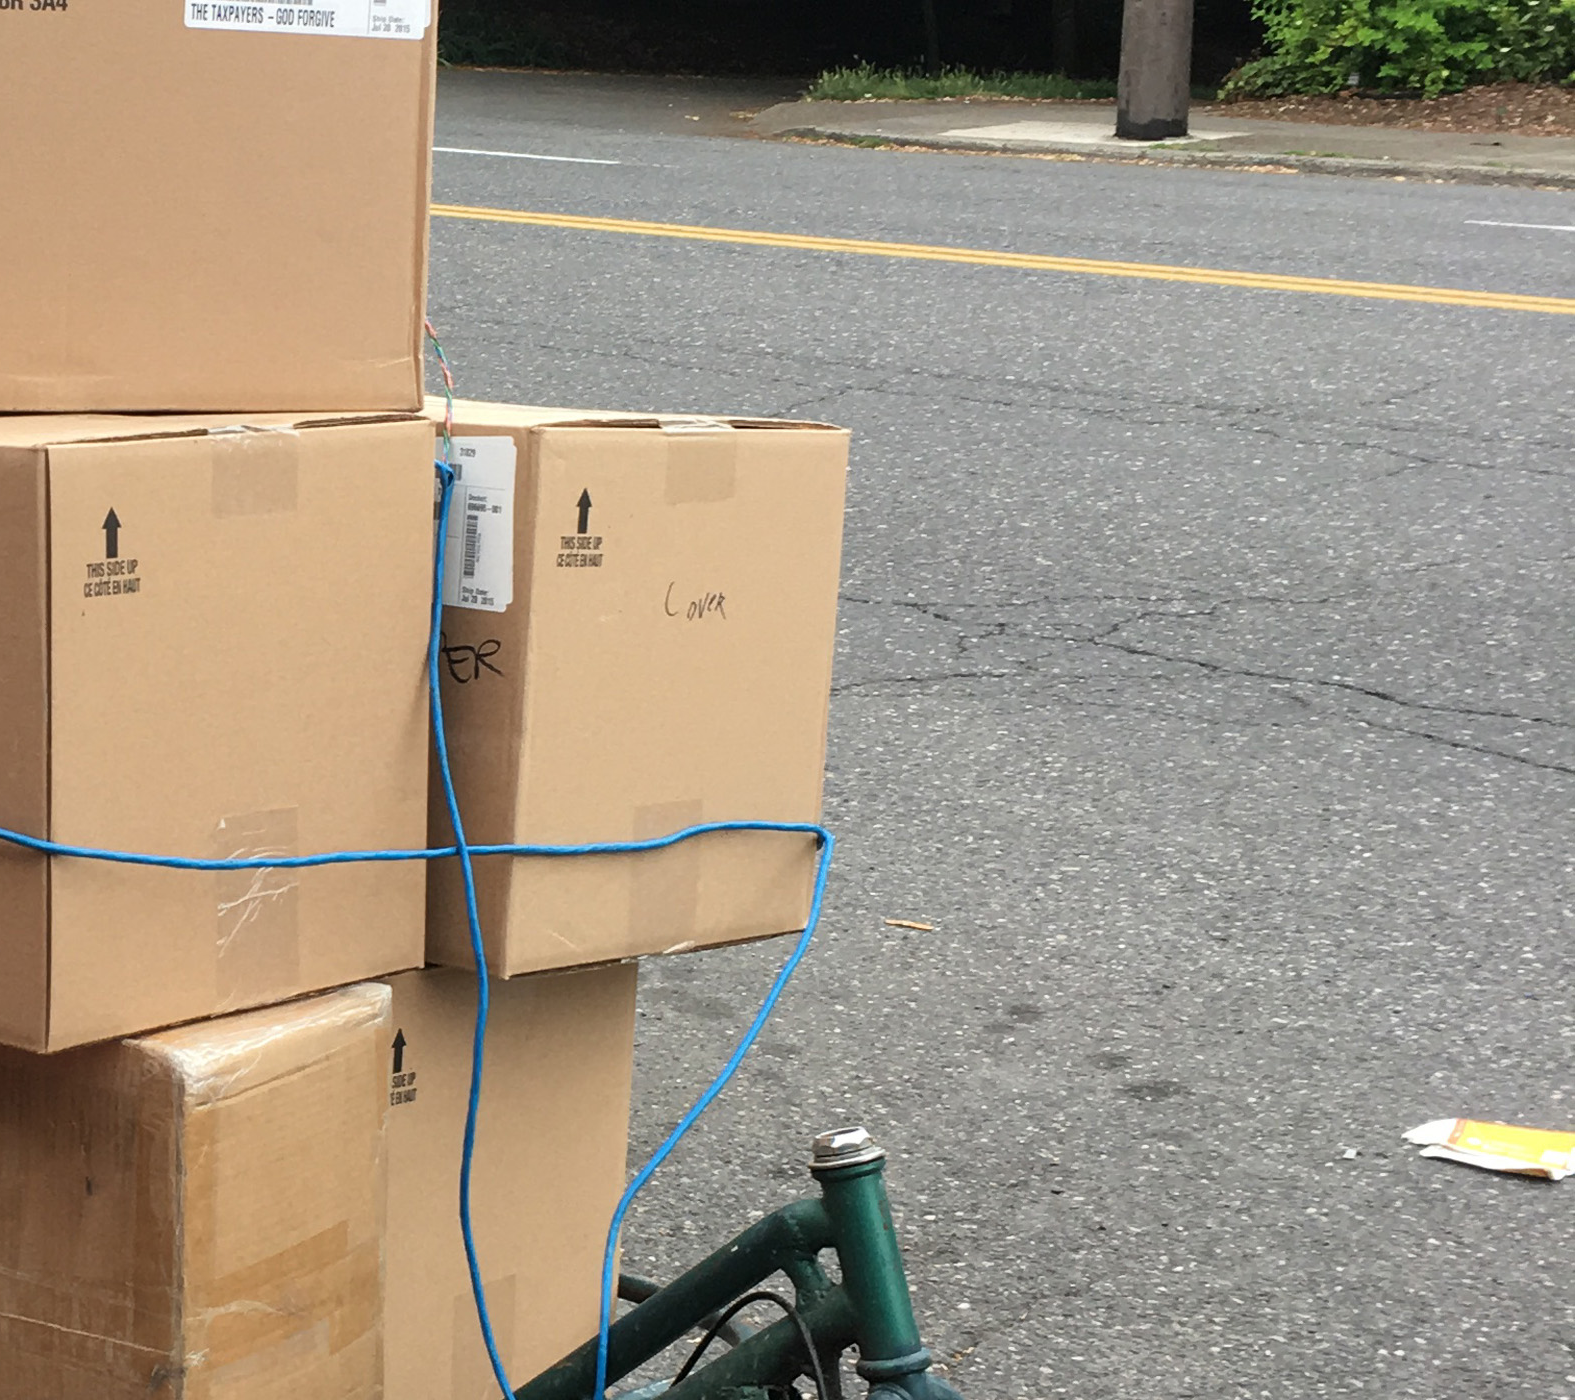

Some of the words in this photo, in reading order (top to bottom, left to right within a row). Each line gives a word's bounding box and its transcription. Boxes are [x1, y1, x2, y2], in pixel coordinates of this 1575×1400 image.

[191, 3, 208, 21] THE
[211, 4, 265, 24] TAXPAYERS
[276, 7, 295, 26] GOD
[297, 9, 336, 28] FORGIVE
[560, 536, 576, 550] THIS
[576, 536, 592, 550] SIDE
[593, 536, 603, 550] UP
[86, 562, 105, 578] THIS
[106, 560, 126, 577] SIDE
[127, 559, 138, 575] UP
[84, 582, 93, 598] CE
[112, 580, 122, 595] EN
[122, 577, 141, 594] HAUT
[440, 631, 505, 684] ER
